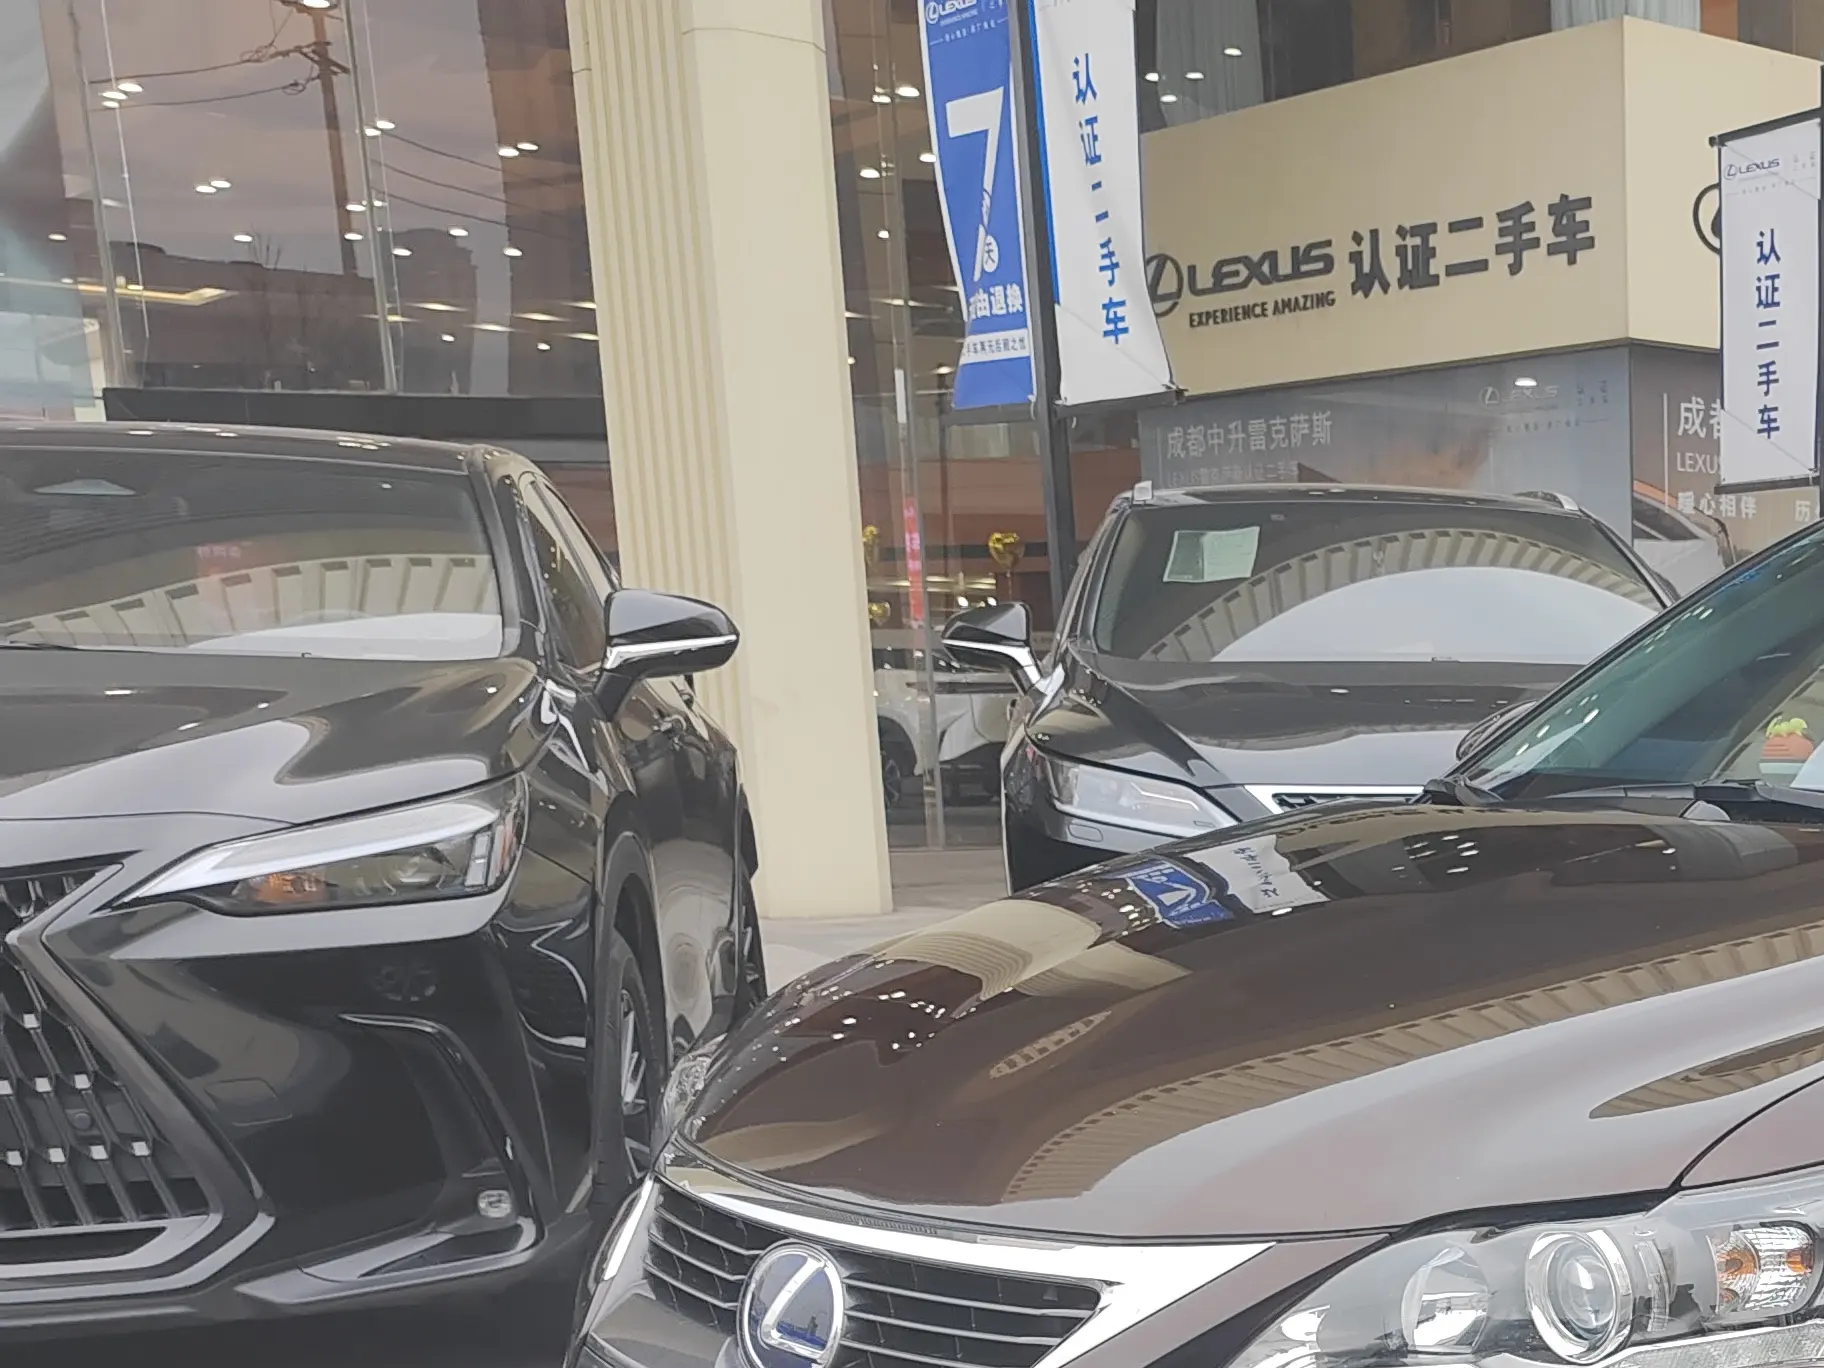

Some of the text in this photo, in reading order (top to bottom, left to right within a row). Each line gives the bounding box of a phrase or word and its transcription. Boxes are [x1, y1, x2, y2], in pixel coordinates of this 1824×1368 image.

[945, 86, 1004, 282] 7
[1072, 53, 1129, 344] 认证二手车
[1739, 158, 1780, 175] LEXUS
[1187, 238, 1335, 296] LEXUS
[1349, 194, 1595, 299] 认证二手车
[1189, 290, 1336, 328] EXPERIENCE AMAZING
[1756, 228, 1781, 439] 认证二手车
[1167, 410, 1333, 459] 成都中升雷克萨斯
